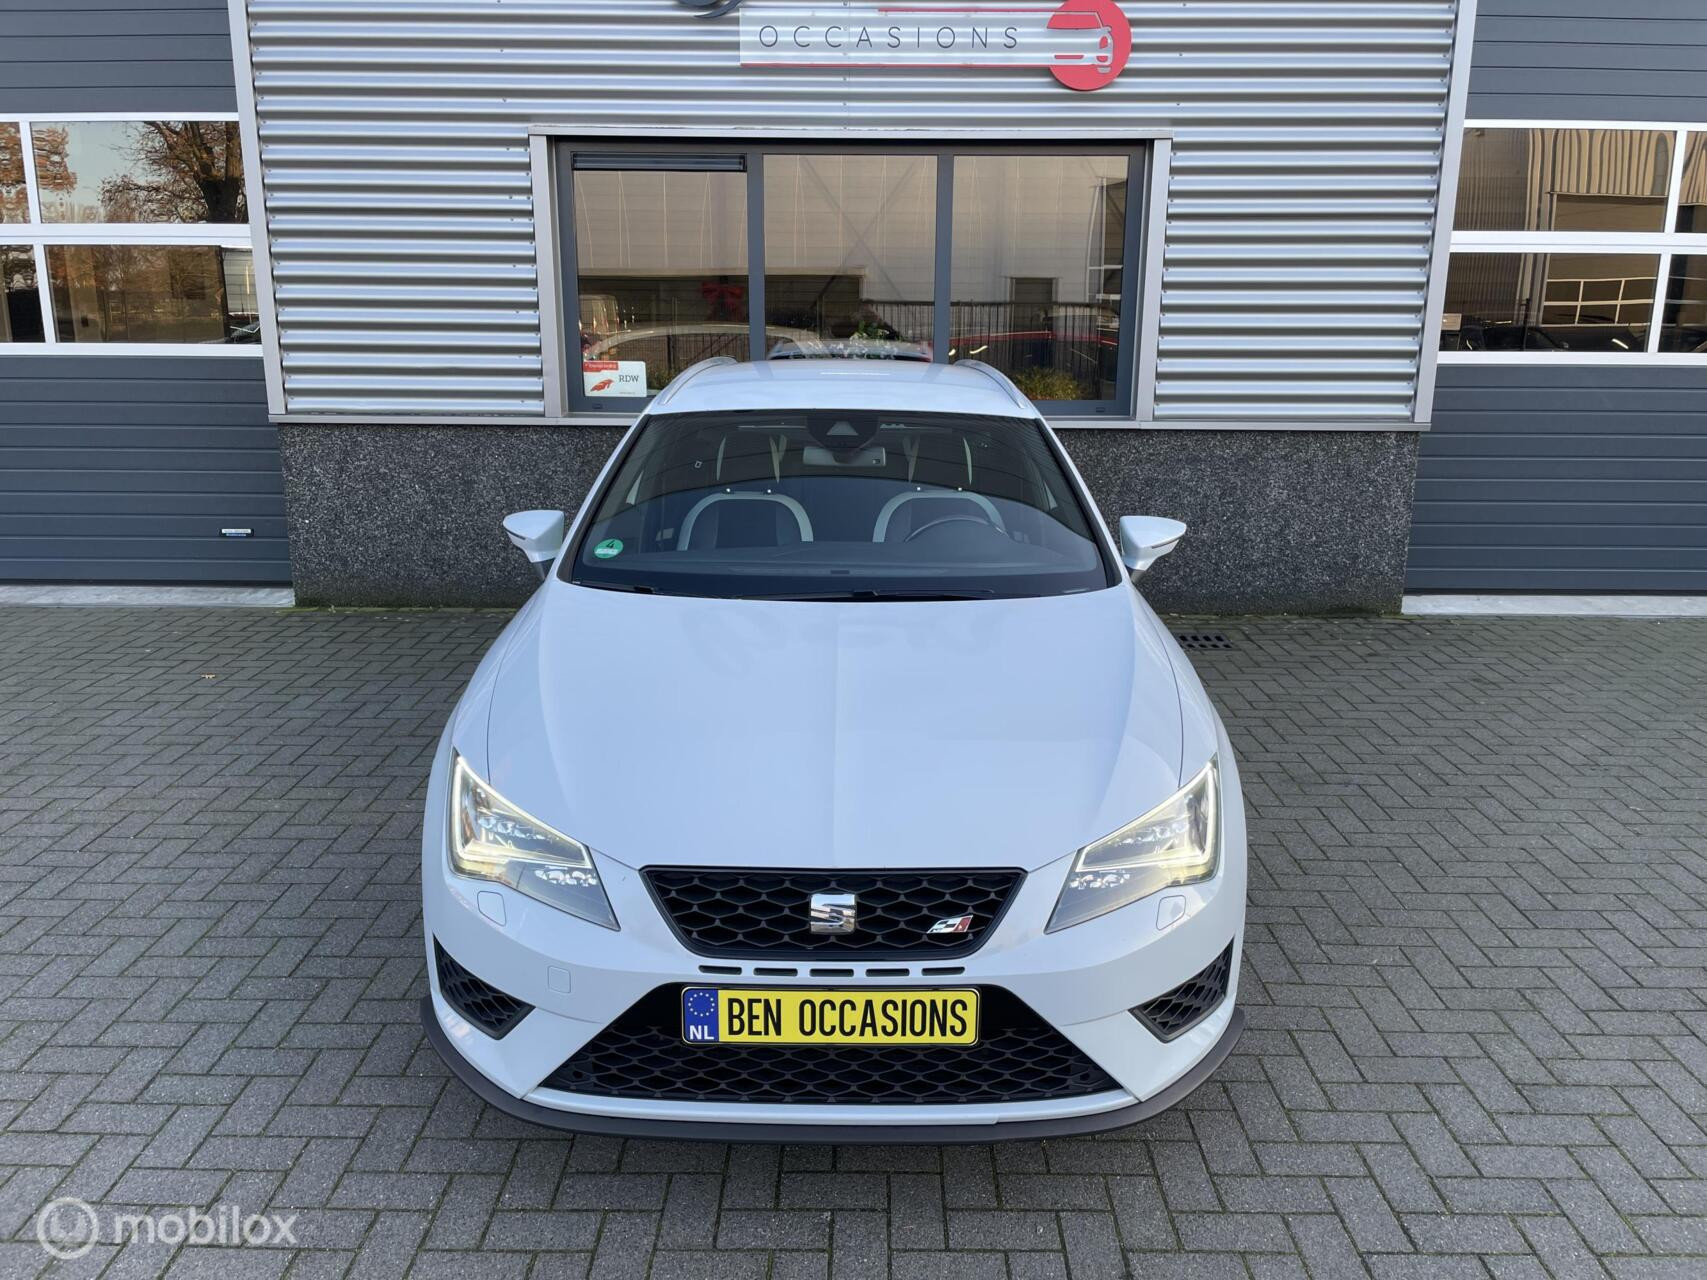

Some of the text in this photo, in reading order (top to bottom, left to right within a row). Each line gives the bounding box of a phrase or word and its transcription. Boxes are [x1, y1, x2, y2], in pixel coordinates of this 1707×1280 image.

[758, 25, 1019, 49] OCCASIONS
[618, 374, 640, 383] RDW
[605, 539, 616, 549] 4
[727, 997, 969, 1038] BEN OCCASIONS
[688, 1024, 715, 1041] NL
